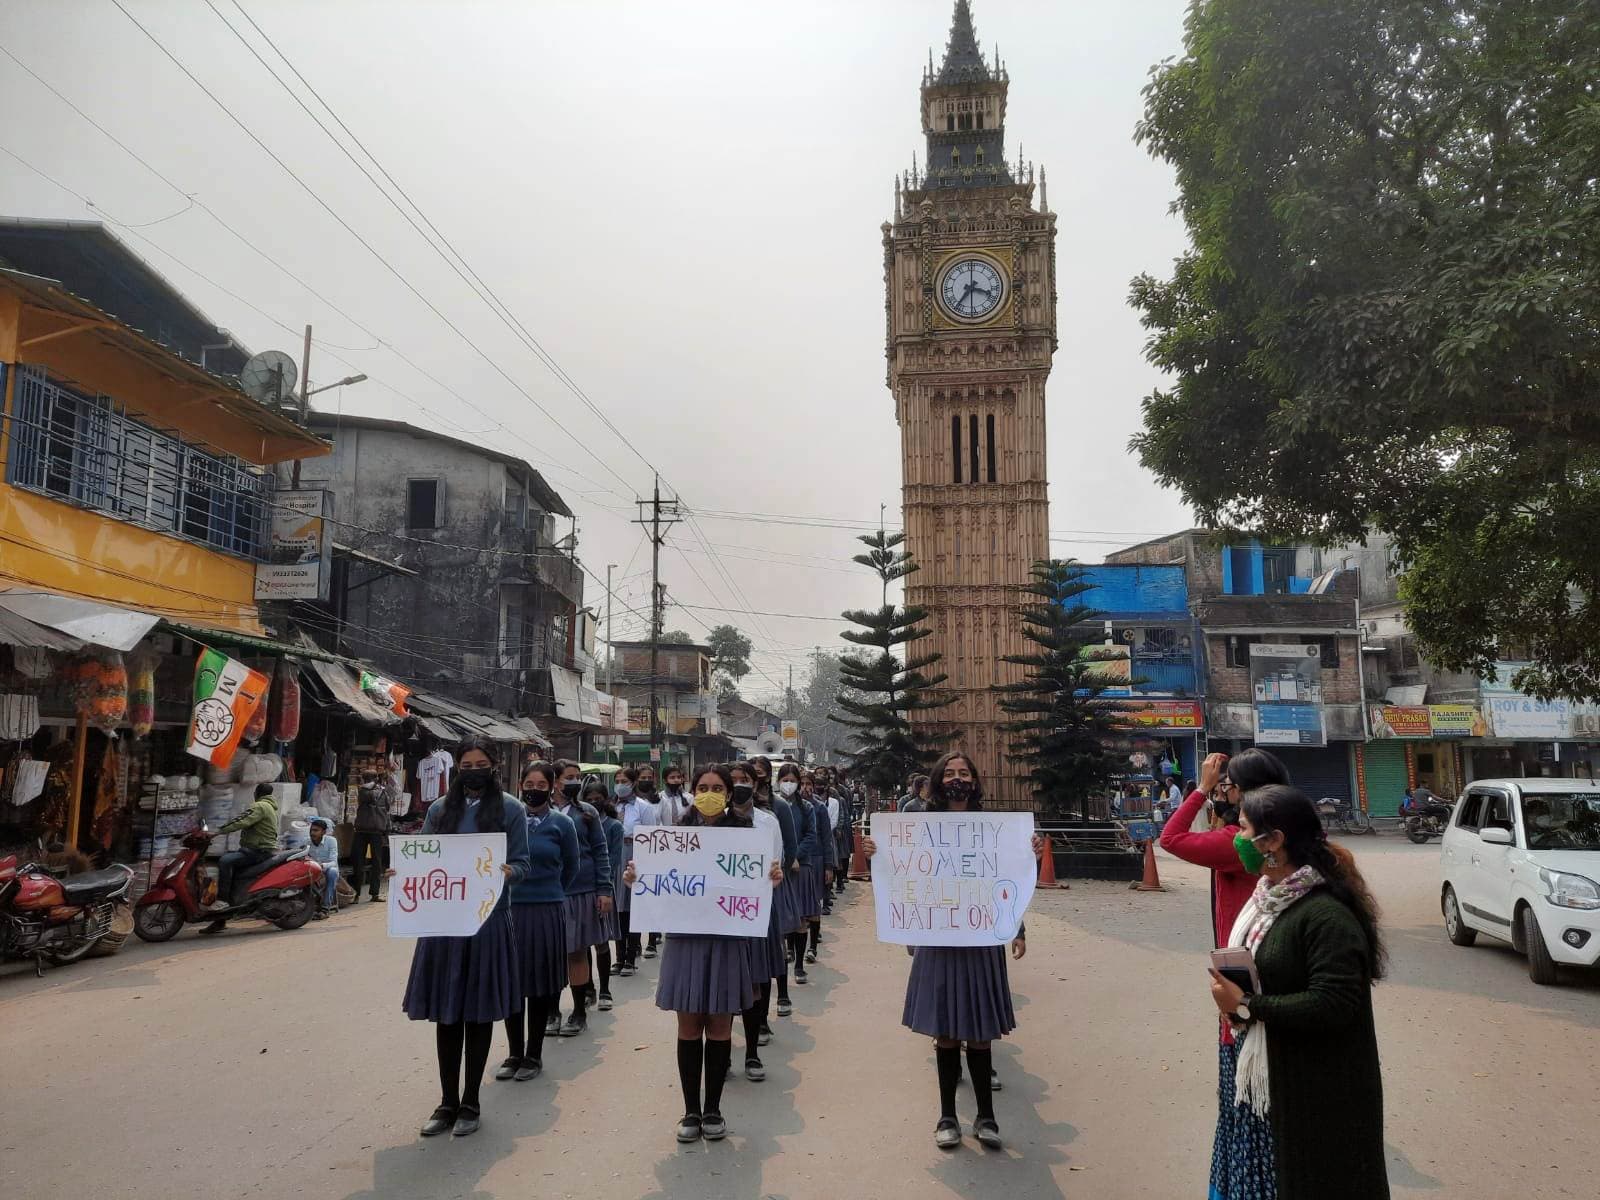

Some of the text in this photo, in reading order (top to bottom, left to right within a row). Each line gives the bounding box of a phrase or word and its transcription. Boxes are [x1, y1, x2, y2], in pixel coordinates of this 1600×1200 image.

[1384, 713, 1428, 722] SHIV PRASAD
[1494, 700, 1519, 712] ROY
[1522, 700, 1532, 712] &
[1534, 701, 1566, 712] SONS
[889, 821, 1004, 849] HEALTHY
[716, 853, 765, 880] থাকুন
[889, 850, 999, 878] WOMEN
[398, 868, 467, 913] सुरक्षित
[634, 868, 706, 897] সাবধানে
[889, 879, 995, 905] HEALTHY
[716, 895, 761, 921] থাকুন
[889, 903, 994, 931] NATION
